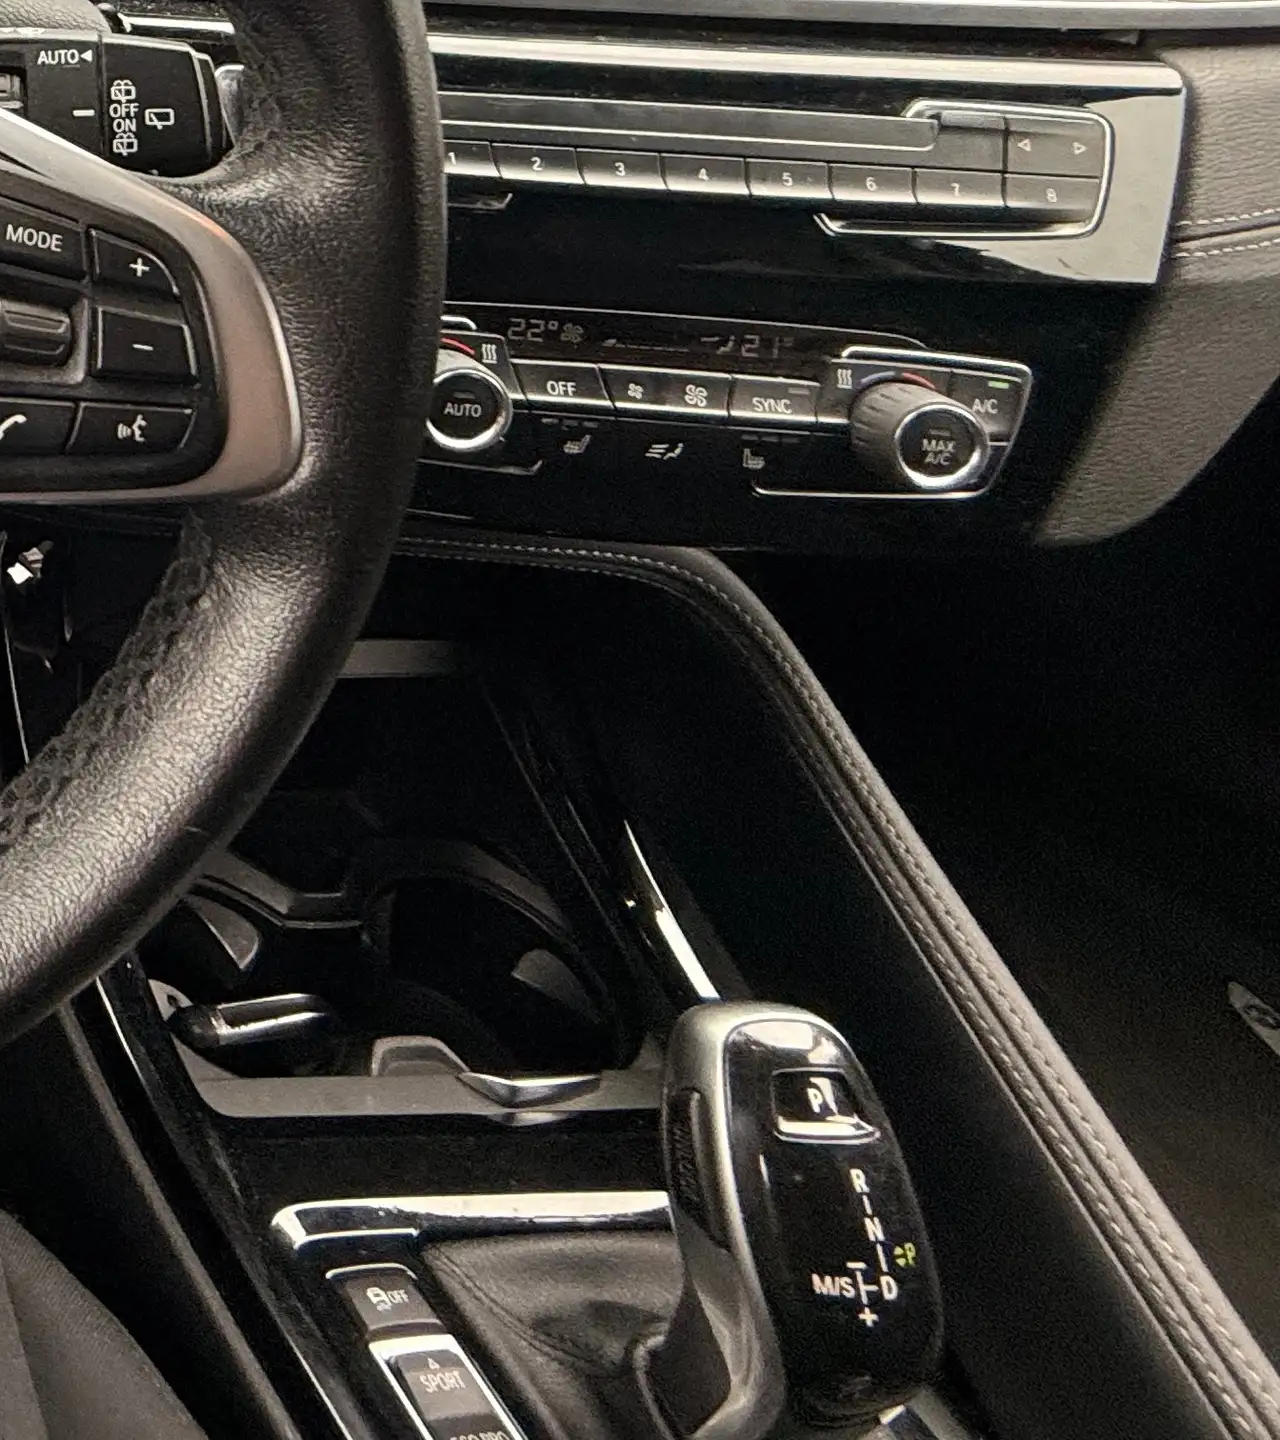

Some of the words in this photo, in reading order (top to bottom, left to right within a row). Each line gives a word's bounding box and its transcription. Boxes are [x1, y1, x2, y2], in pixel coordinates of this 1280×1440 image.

[37, 50, 79, 65] AUTO
[109, 103, 139, 118] OFF
[112, 117, 137, 133] ON
[447, 151, 457, 166] 1
[530, 156, 543, 171] 2
[614, 162, 626, 176] 3
[697, 167, 710, 182] 4
[781, 171, 793, 187] 5
[866, 176, 877, 191] 6
[950, 182, 961, 197] 7
[1045, 188, 1057, 203] 8
[5, 224, 64, 253] MODE
[546, 380, 577, 397] OFF
[443, 401, 482, 418] AUTO
[752, 397, 793, 414] SYNC
[971, 398, 999, 414] A/C
[921, 438, 957, 453] MAX
[924, 451, 953, 466] A/C
[807, 1086, 824, 1113] P
[849, 1167, 870, 1194] R
[863, 1216, 885, 1242] N
[811, 1272, 855, 1298] M/S
[879, 1274, 899, 1301] D
[419, 1370, 466, 1394] SPORT
